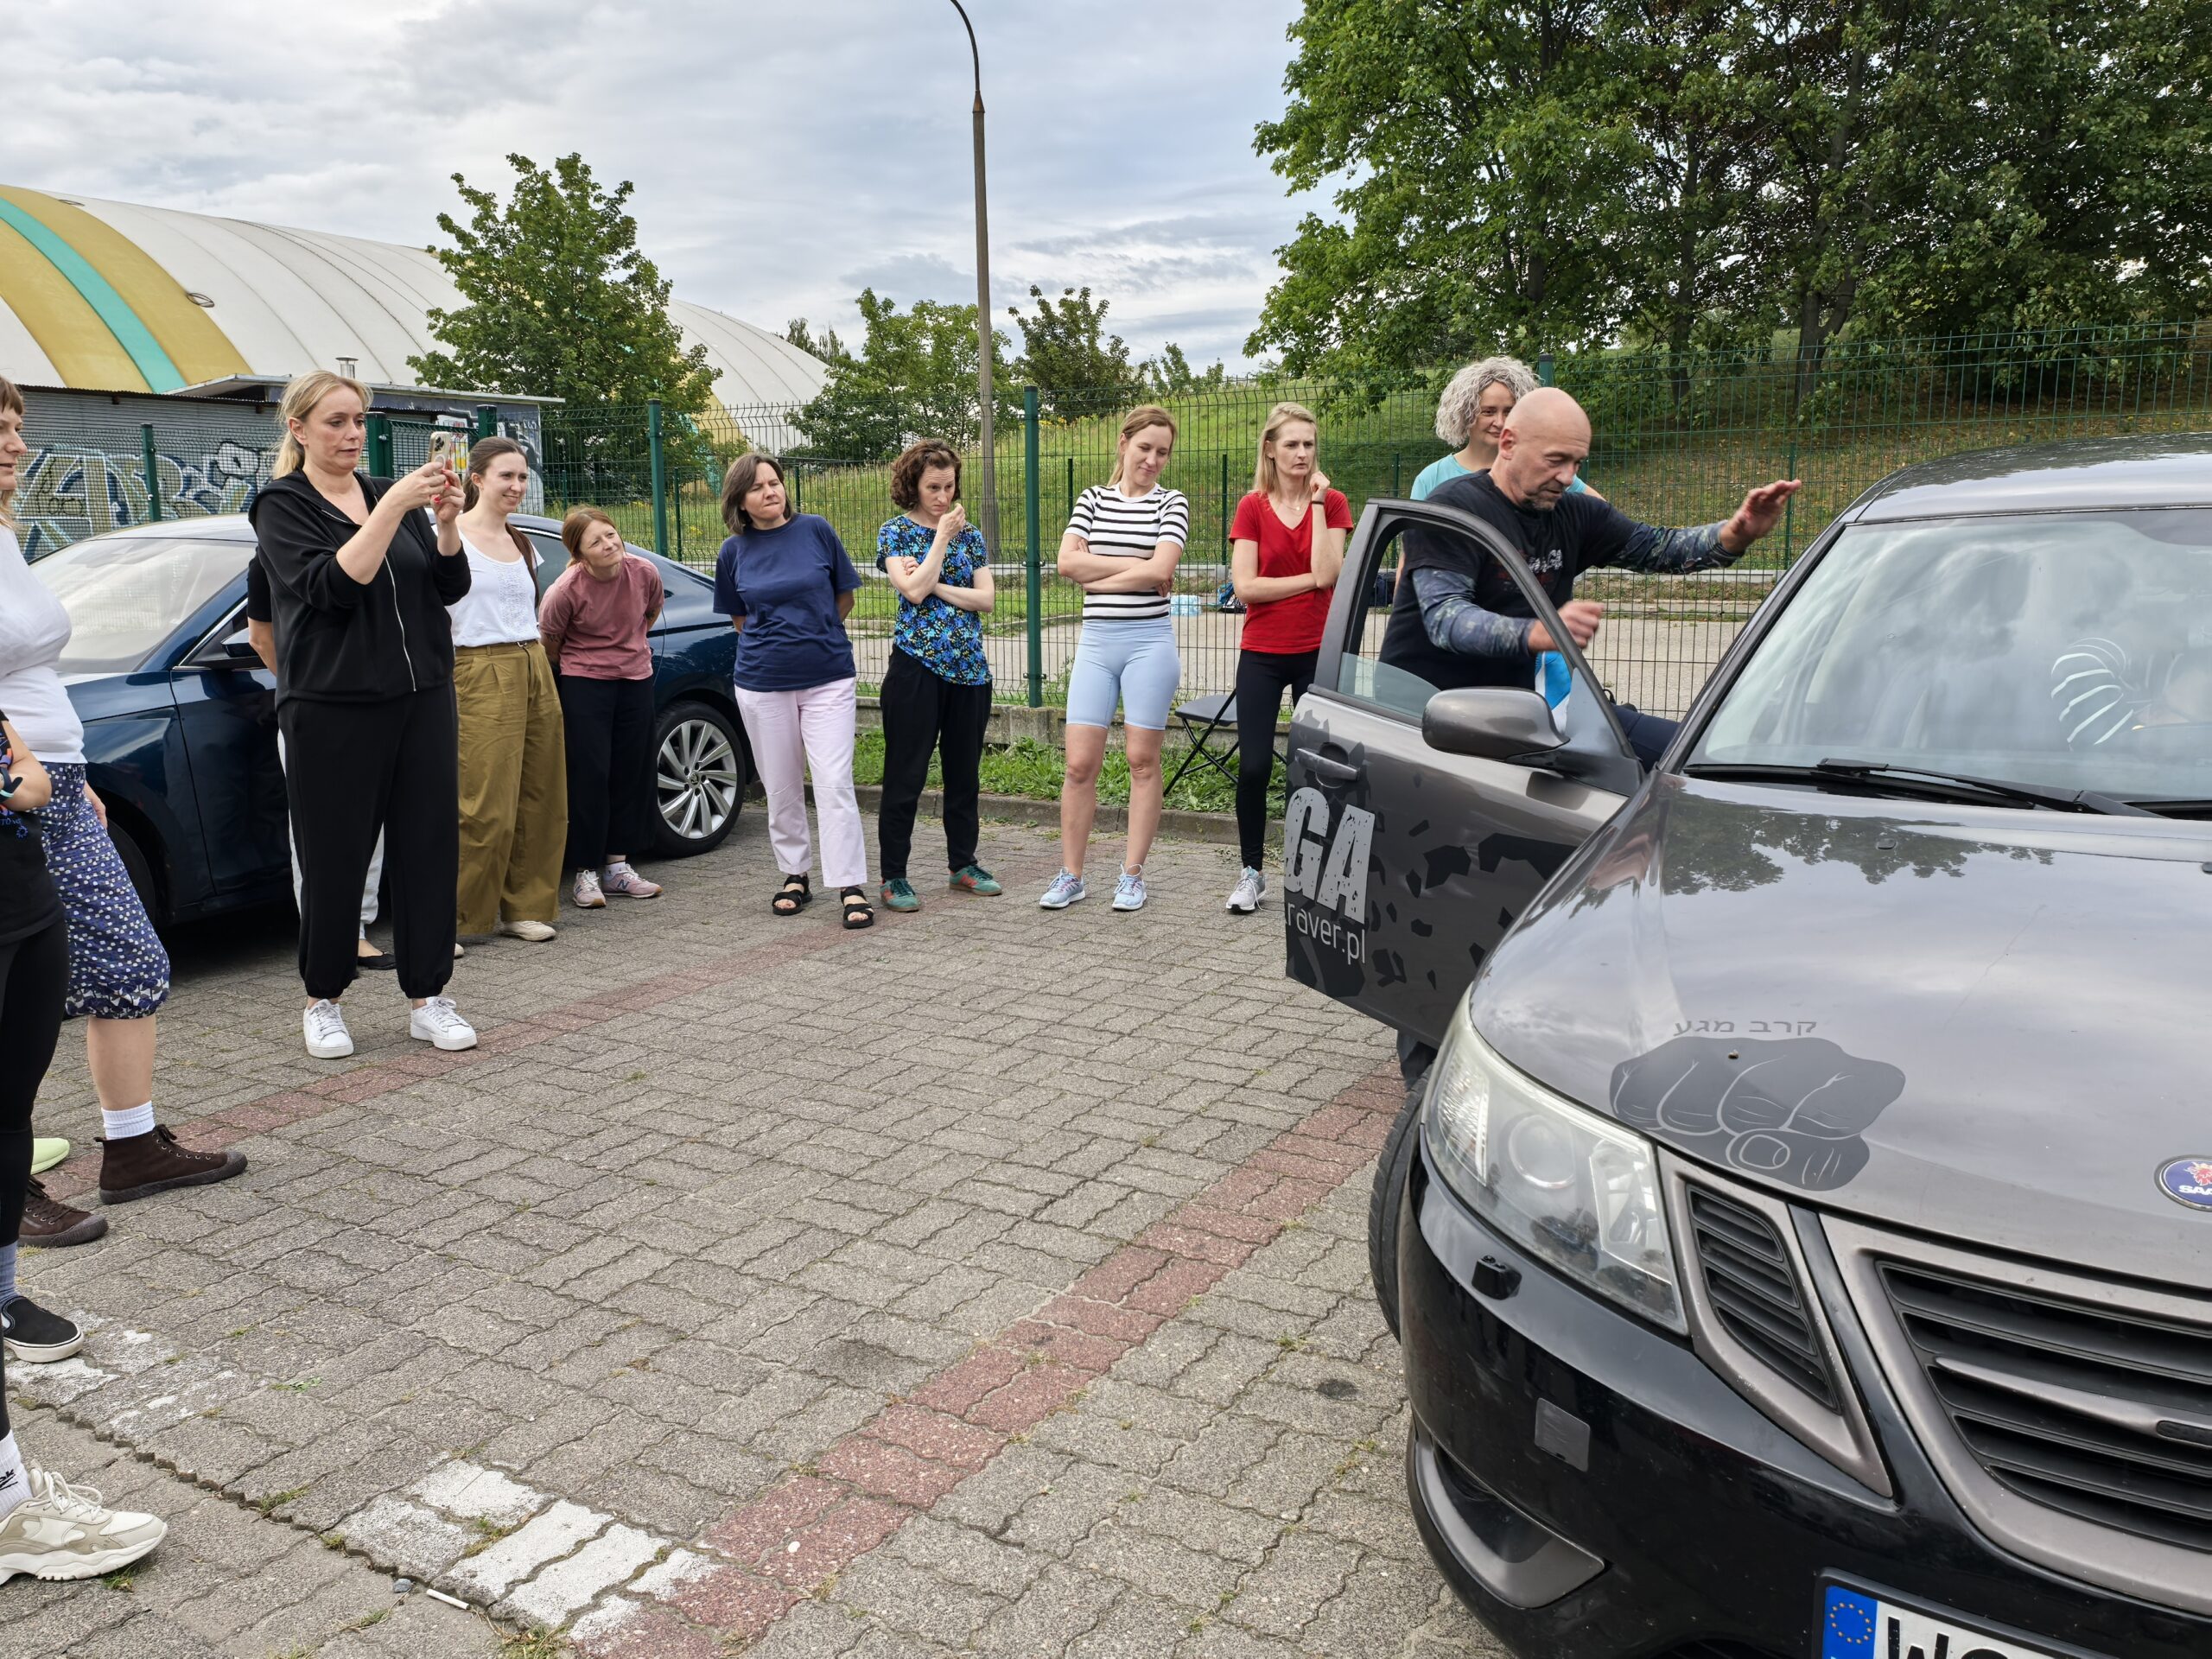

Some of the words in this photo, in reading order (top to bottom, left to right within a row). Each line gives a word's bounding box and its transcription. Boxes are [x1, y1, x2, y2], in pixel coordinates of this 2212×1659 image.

[1284, 787, 1375, 925] GA
[1286, 902, 1365, 965] raver.pl
[1673, 1020, 1734, 1037] מגע
[1749, 1020, 1817, 1036] קרב
